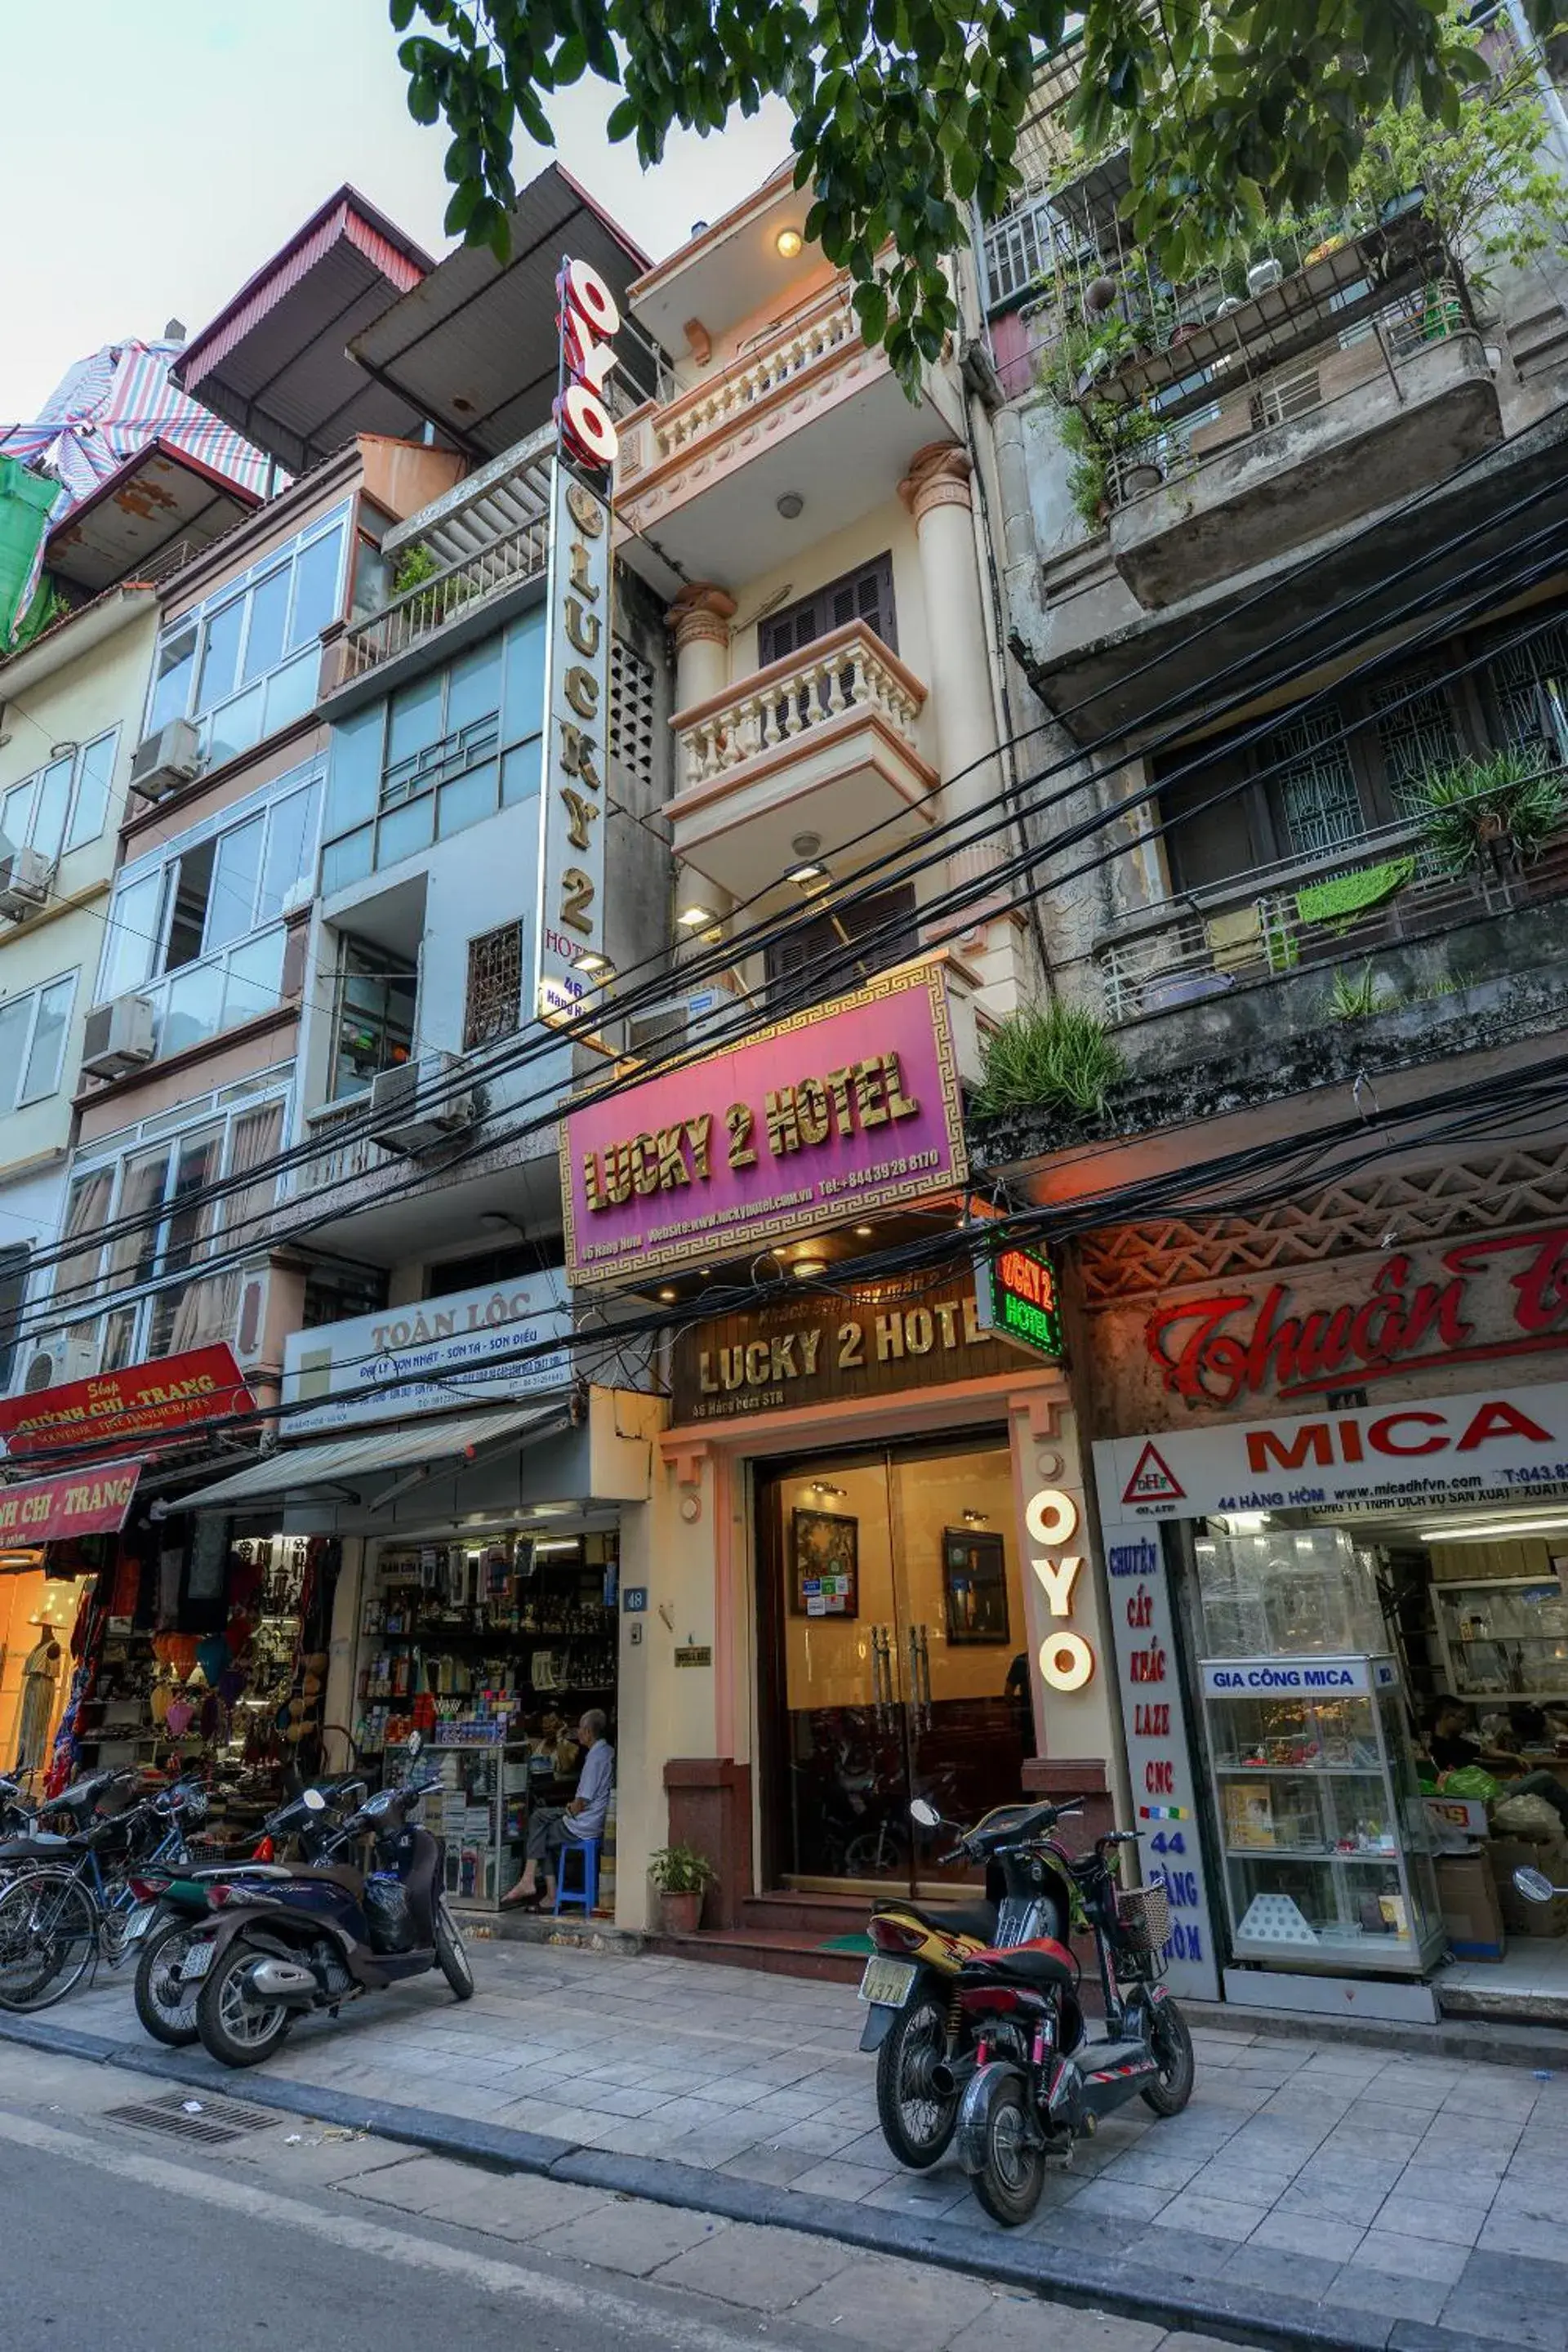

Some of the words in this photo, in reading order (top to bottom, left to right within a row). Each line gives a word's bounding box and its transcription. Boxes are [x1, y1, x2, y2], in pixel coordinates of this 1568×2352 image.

[553, 259, 619, 470] OYO
[559, 542, 603, 850] LUCKY
[559, 867, 595, 935] 2
[564, 976, 582, 998] 46
[583, 1112, 713, 1212] LUCKY
[724, 1102, 756, 1167] 2
[764, 1051, 920, 1156] HOTEL
[1004, 1292, 1052, 1343] HOTEL
[699, 1326, 822, 1395] LUCKY
[837, 1321, 865, 1370] 2
[875, 1294, 991, 1361] HOTE
[89, 1397, 123, 1417] CHI
[136, 1374, 216, 1406] TRANG
[1245, 1401, 1556, 1474] MICA
[63, 1476, 132, 1516] TRANG
[1218, 1496, 1236, 1511] 44
[1239, 1489, 1284, 1509] HÀNG
[1334, 1473, 1482, 1500] www.micadhfvn.com
[627, 1592, 643, 1608] 48
[1025, 1489, 1095, 1691] OYO
[1213, 1672, 1245, 1687] GIA
[1248, 1668, 1301, 1687] CÔNG
[1303, 1669, 1354, 1686] MICA
[1134, 1703, 1170, 1737] LAZE
[1145, 1760, 1174, 1794] CNC
[1150, 1831, 1185, 1855] 44
